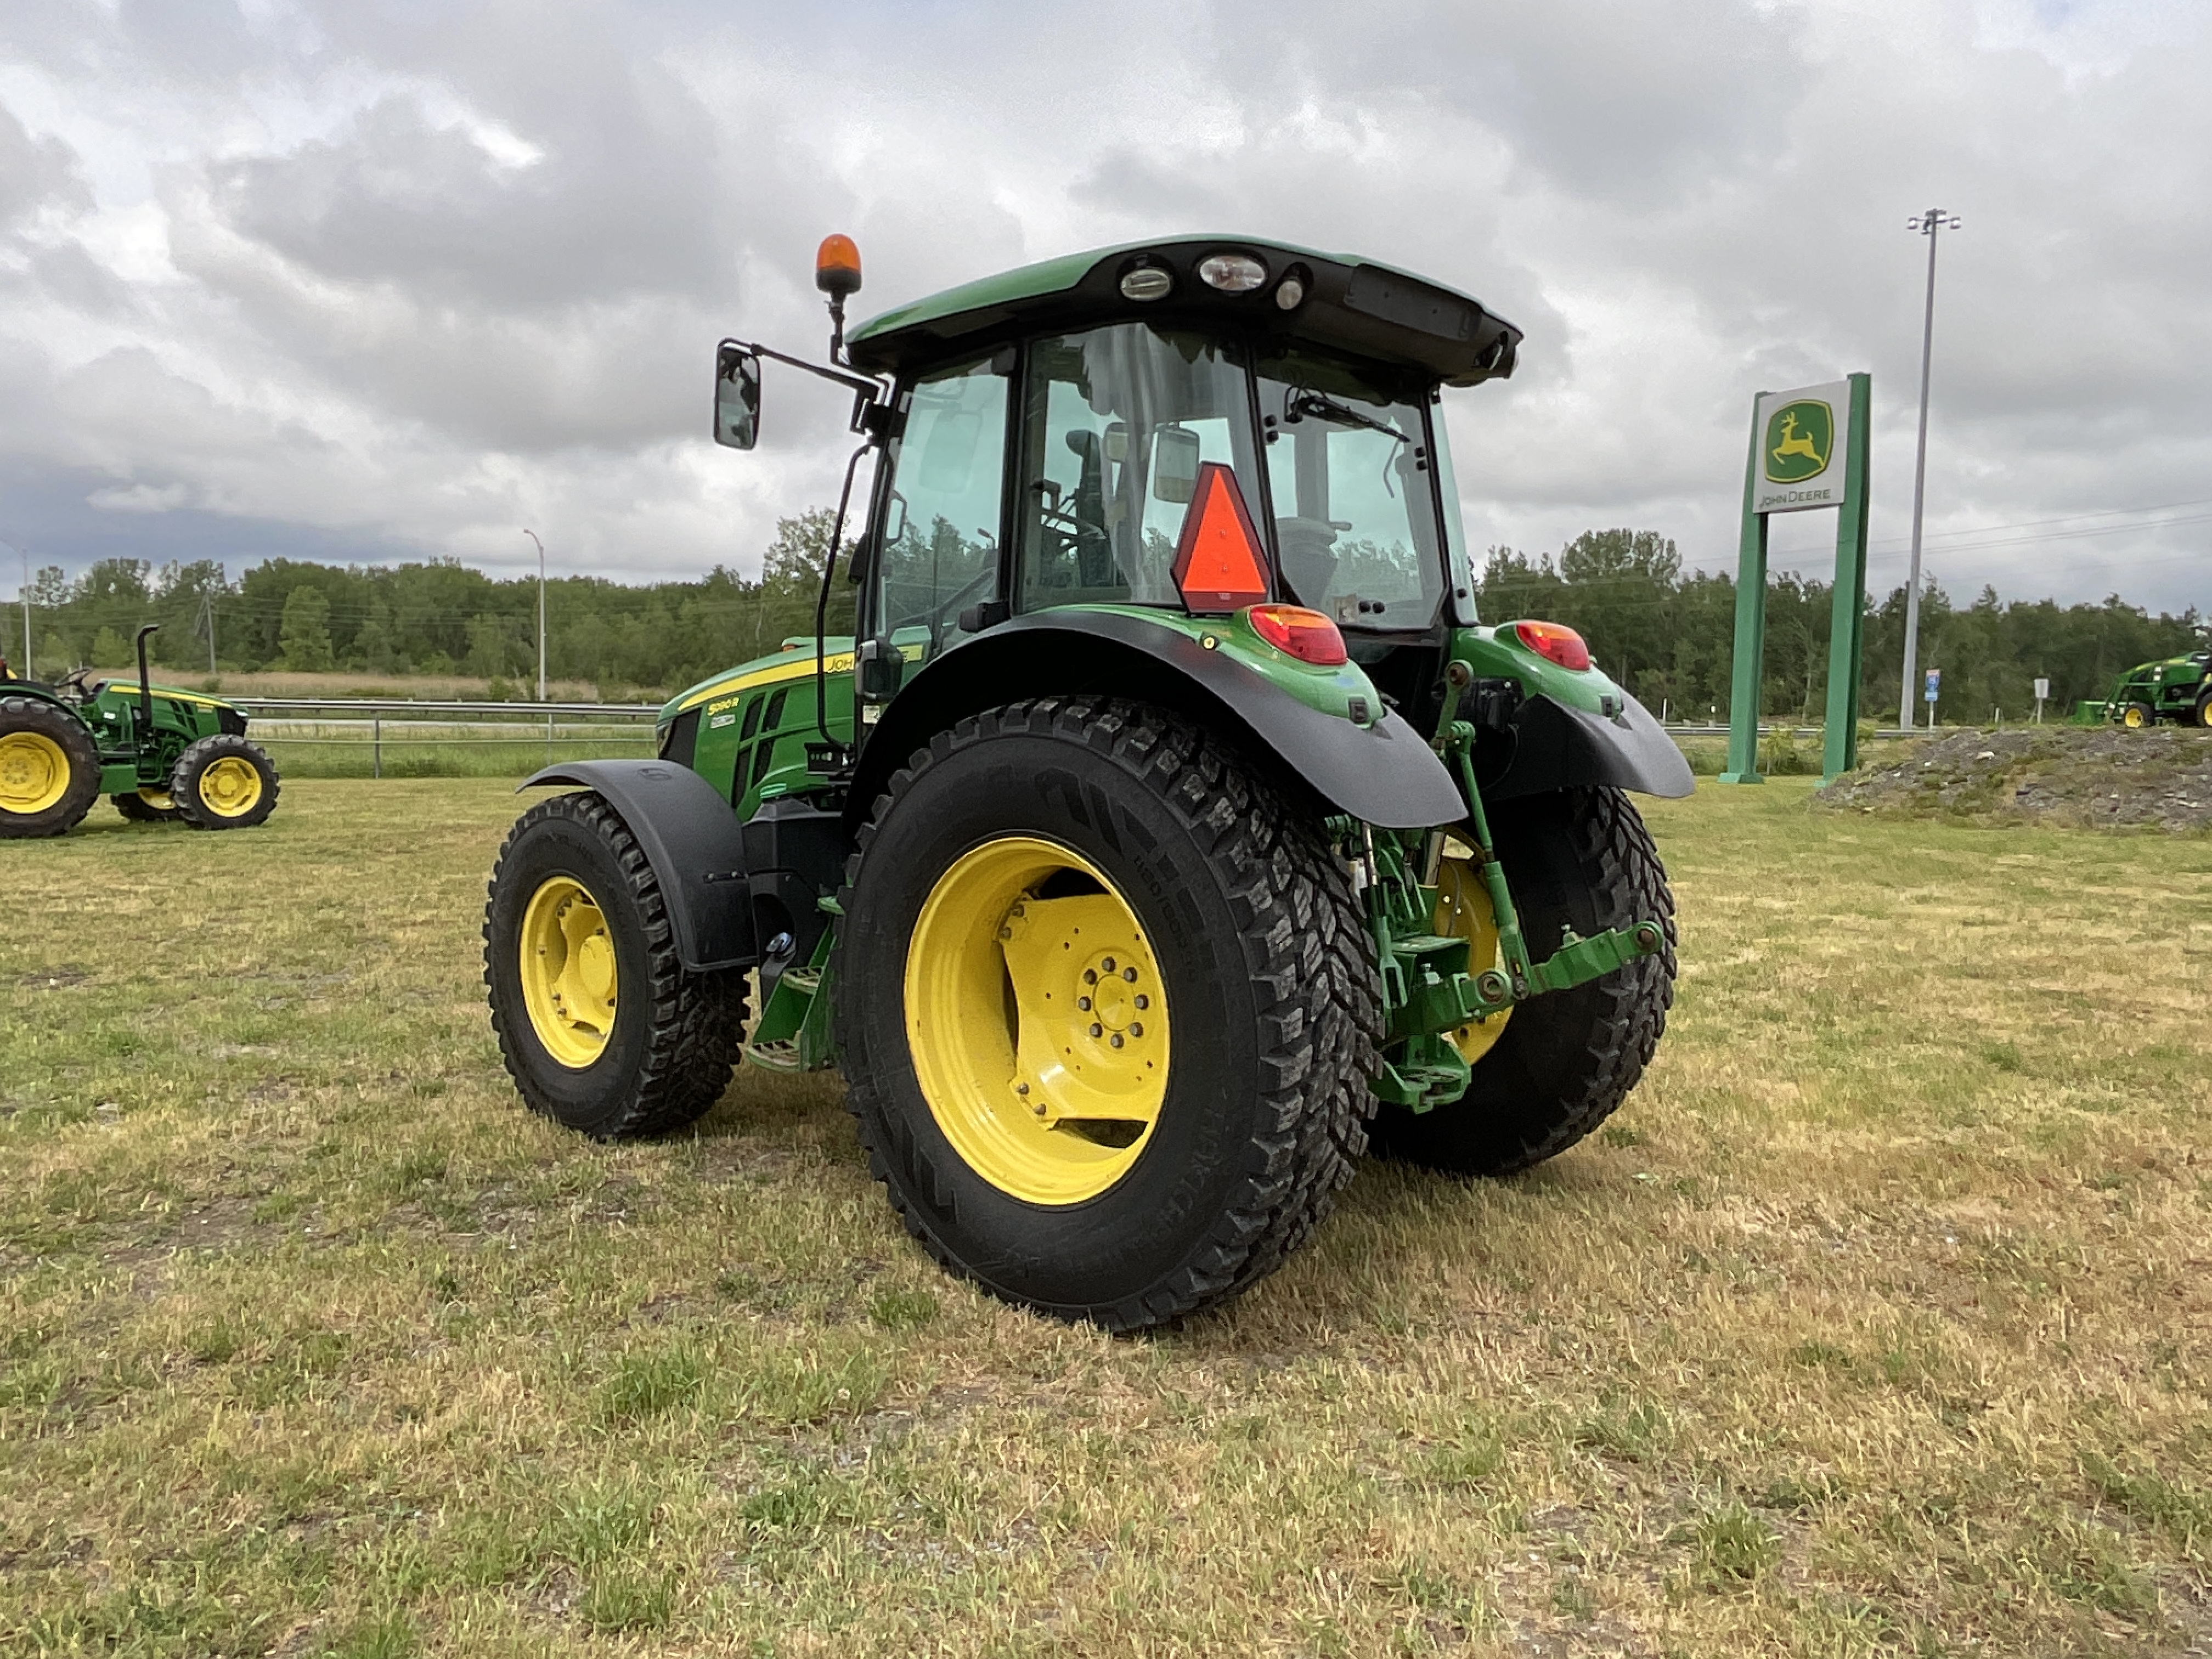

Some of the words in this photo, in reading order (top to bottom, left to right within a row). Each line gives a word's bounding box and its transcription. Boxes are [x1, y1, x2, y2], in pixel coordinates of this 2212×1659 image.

[1759, 494, 1787, 509] JOHN
[1788, 488, 1831, 502] DEERE
[827, 657, 853, 672] JOH
